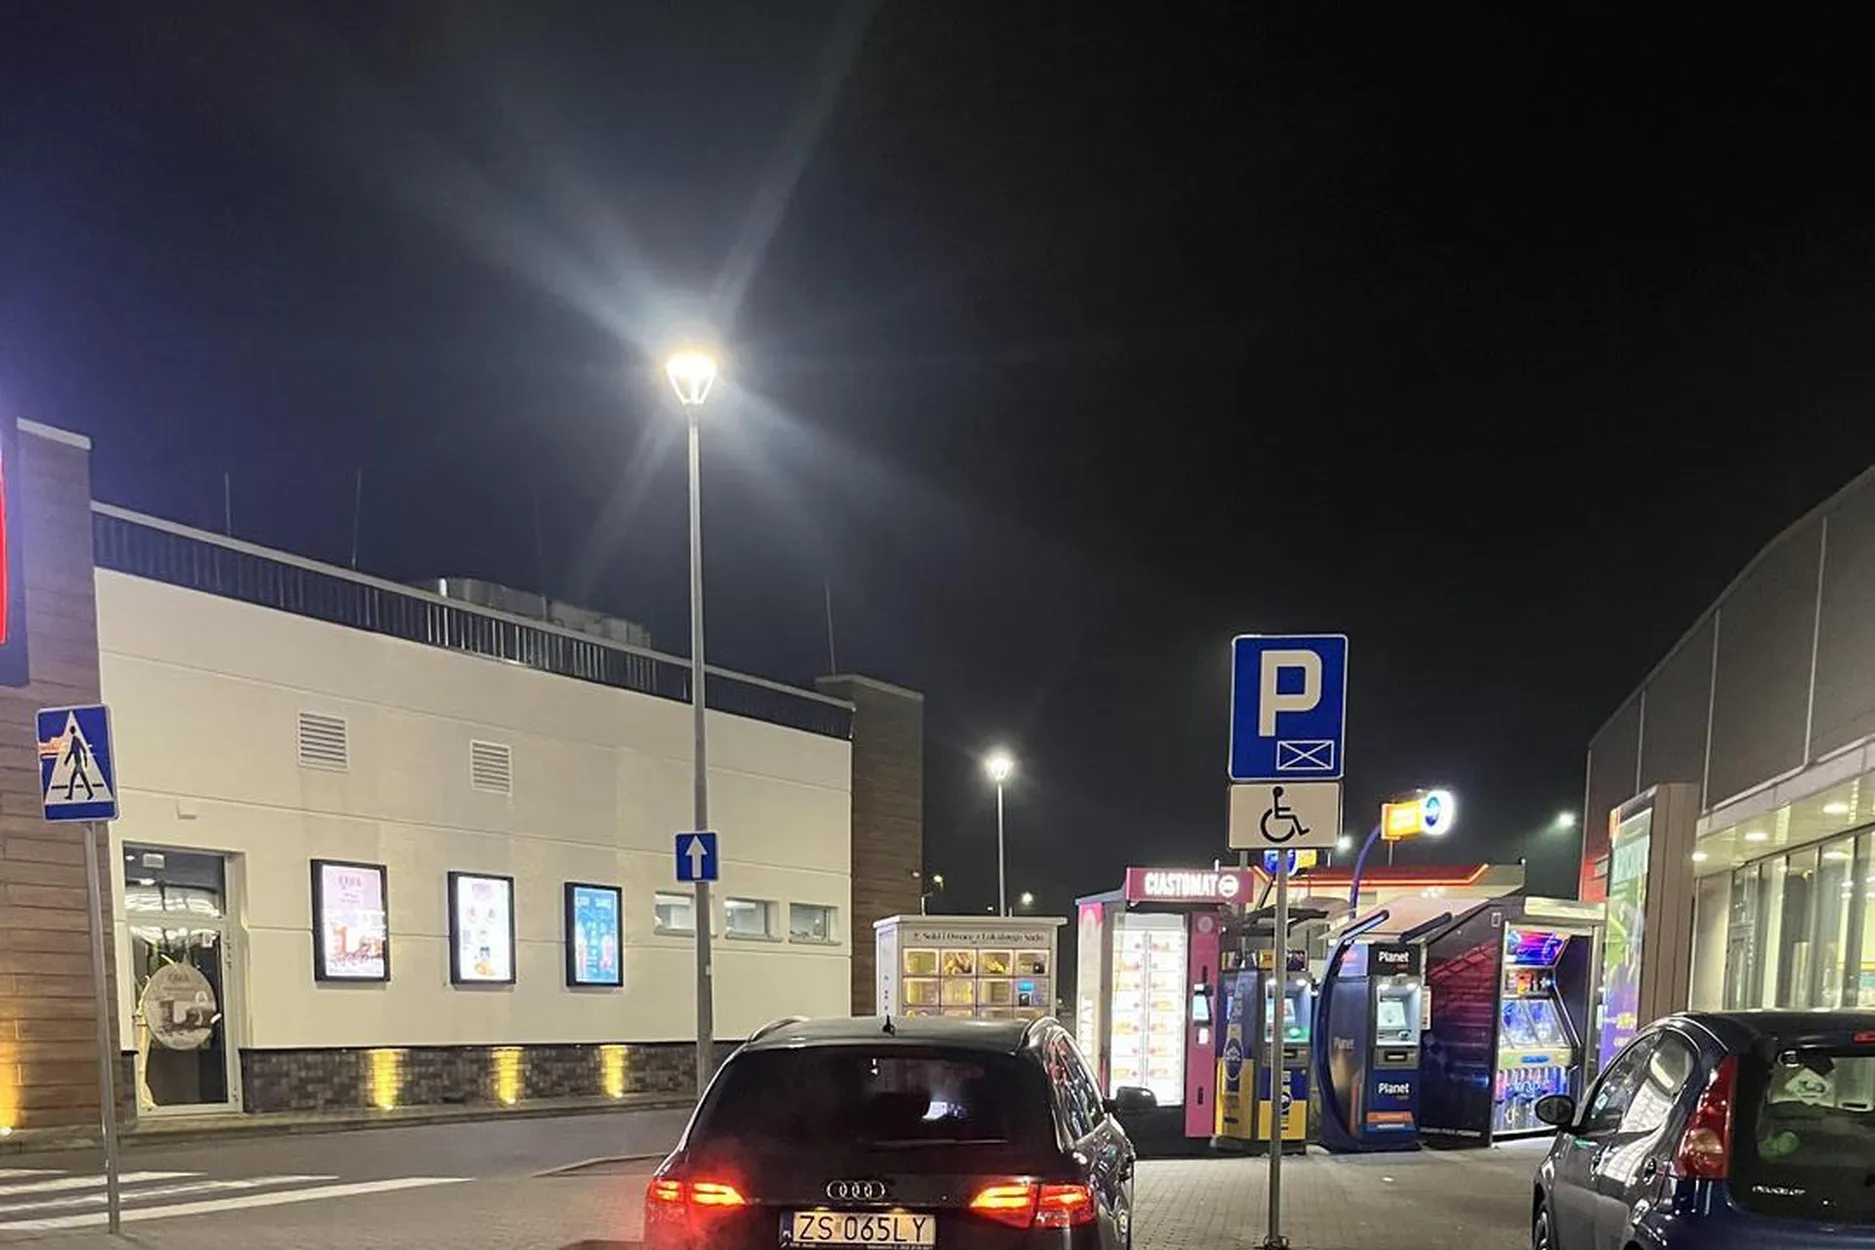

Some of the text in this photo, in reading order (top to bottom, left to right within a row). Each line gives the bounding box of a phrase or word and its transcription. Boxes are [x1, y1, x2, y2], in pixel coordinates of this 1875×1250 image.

[1259, 650, 1322, 736] P
[1144, 872, 1219, 898] CIASTOMAT
[1378, 950, 1409, 964] Planet
[1378, 1082, 1410, 1095] Planet
[800, 1215, 927, 1242] ZS 065LY
